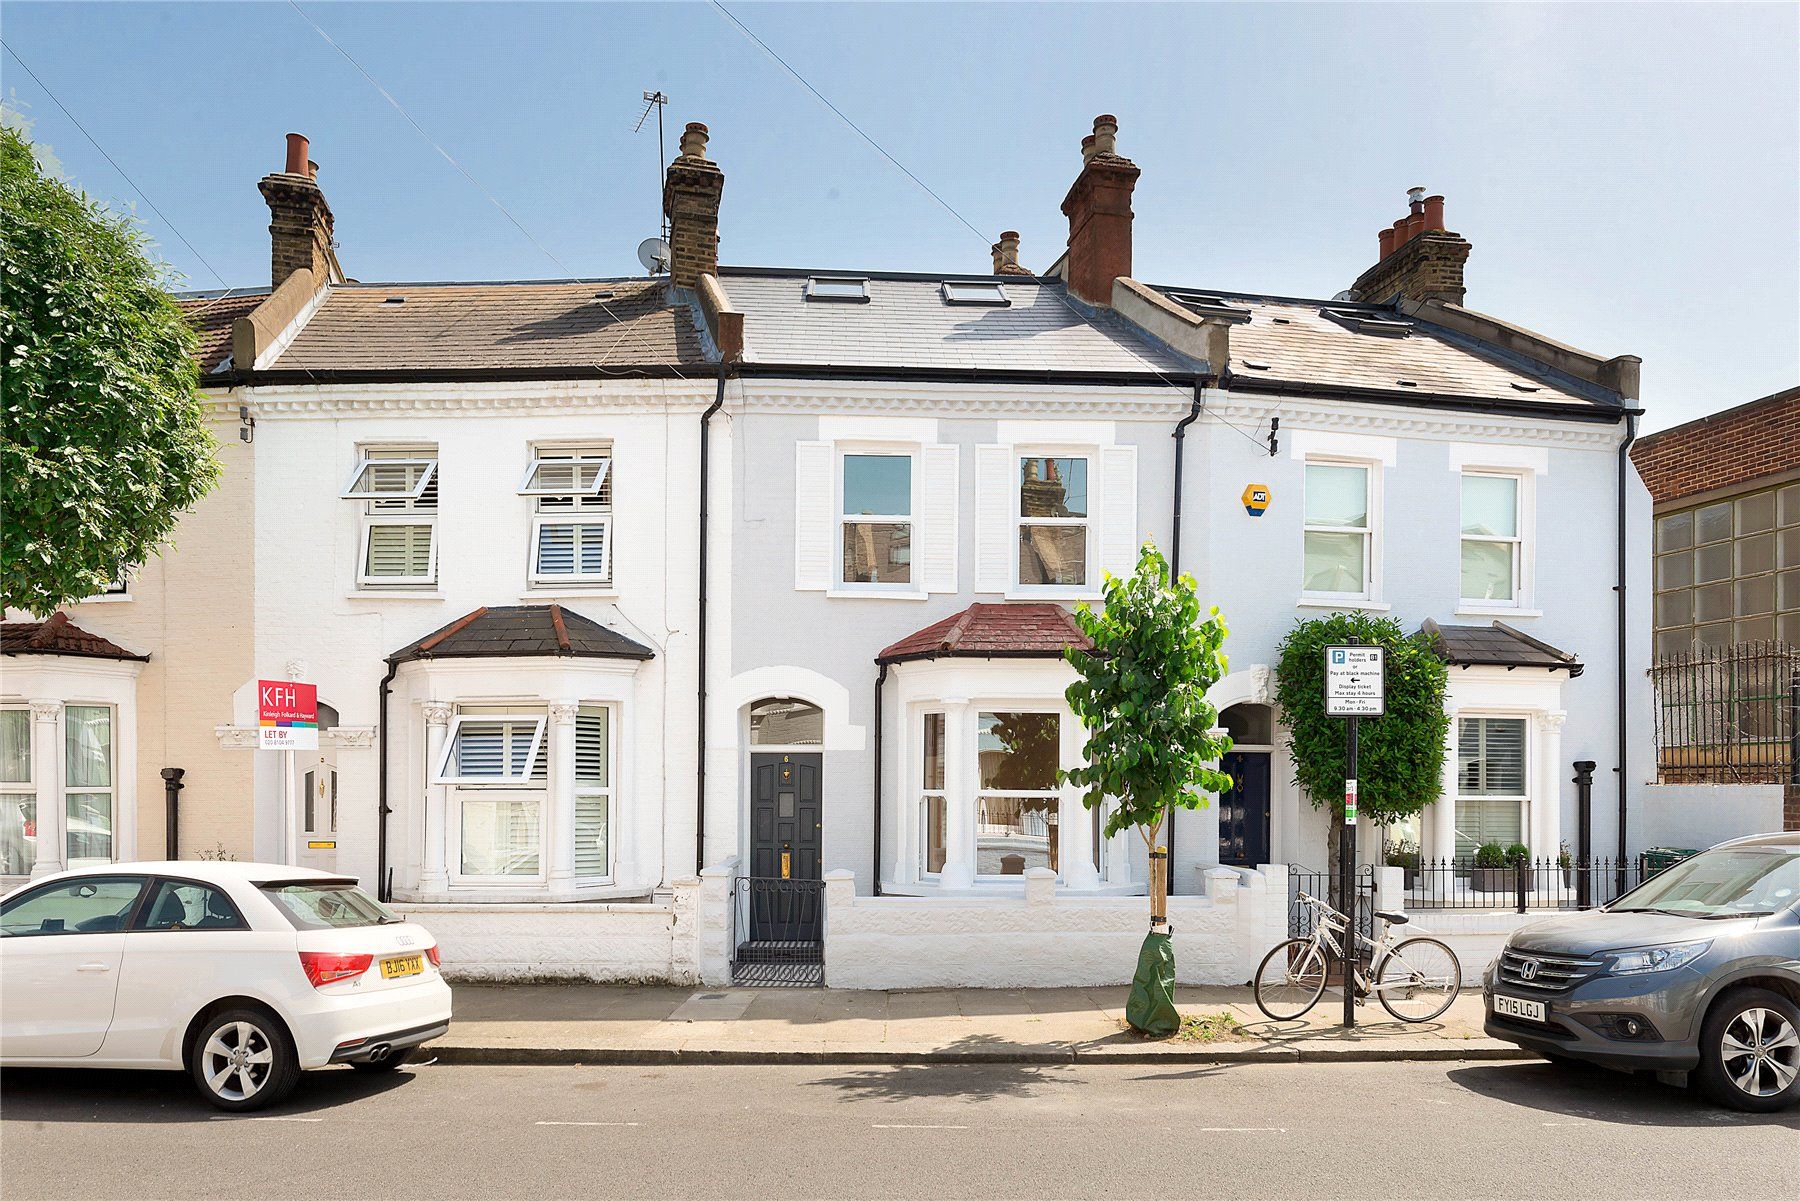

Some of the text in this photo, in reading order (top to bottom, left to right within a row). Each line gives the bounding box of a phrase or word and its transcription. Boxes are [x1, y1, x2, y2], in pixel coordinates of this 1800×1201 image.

[1253, 491, 1265, 501] ADT
[1335, 651, 1344, 663] P
[262, 686, 296, 708] KFH
[263, 710, 280, 719] Kinleigh
[300, 712, 315, 720] Hayward
[264, 730, 288, 739] LET BY
[783, 755, 789, 763] 6
[386, 959, 405, 974] BJ16
[1498, 997, 1539, 1018] FY15 LGJ
